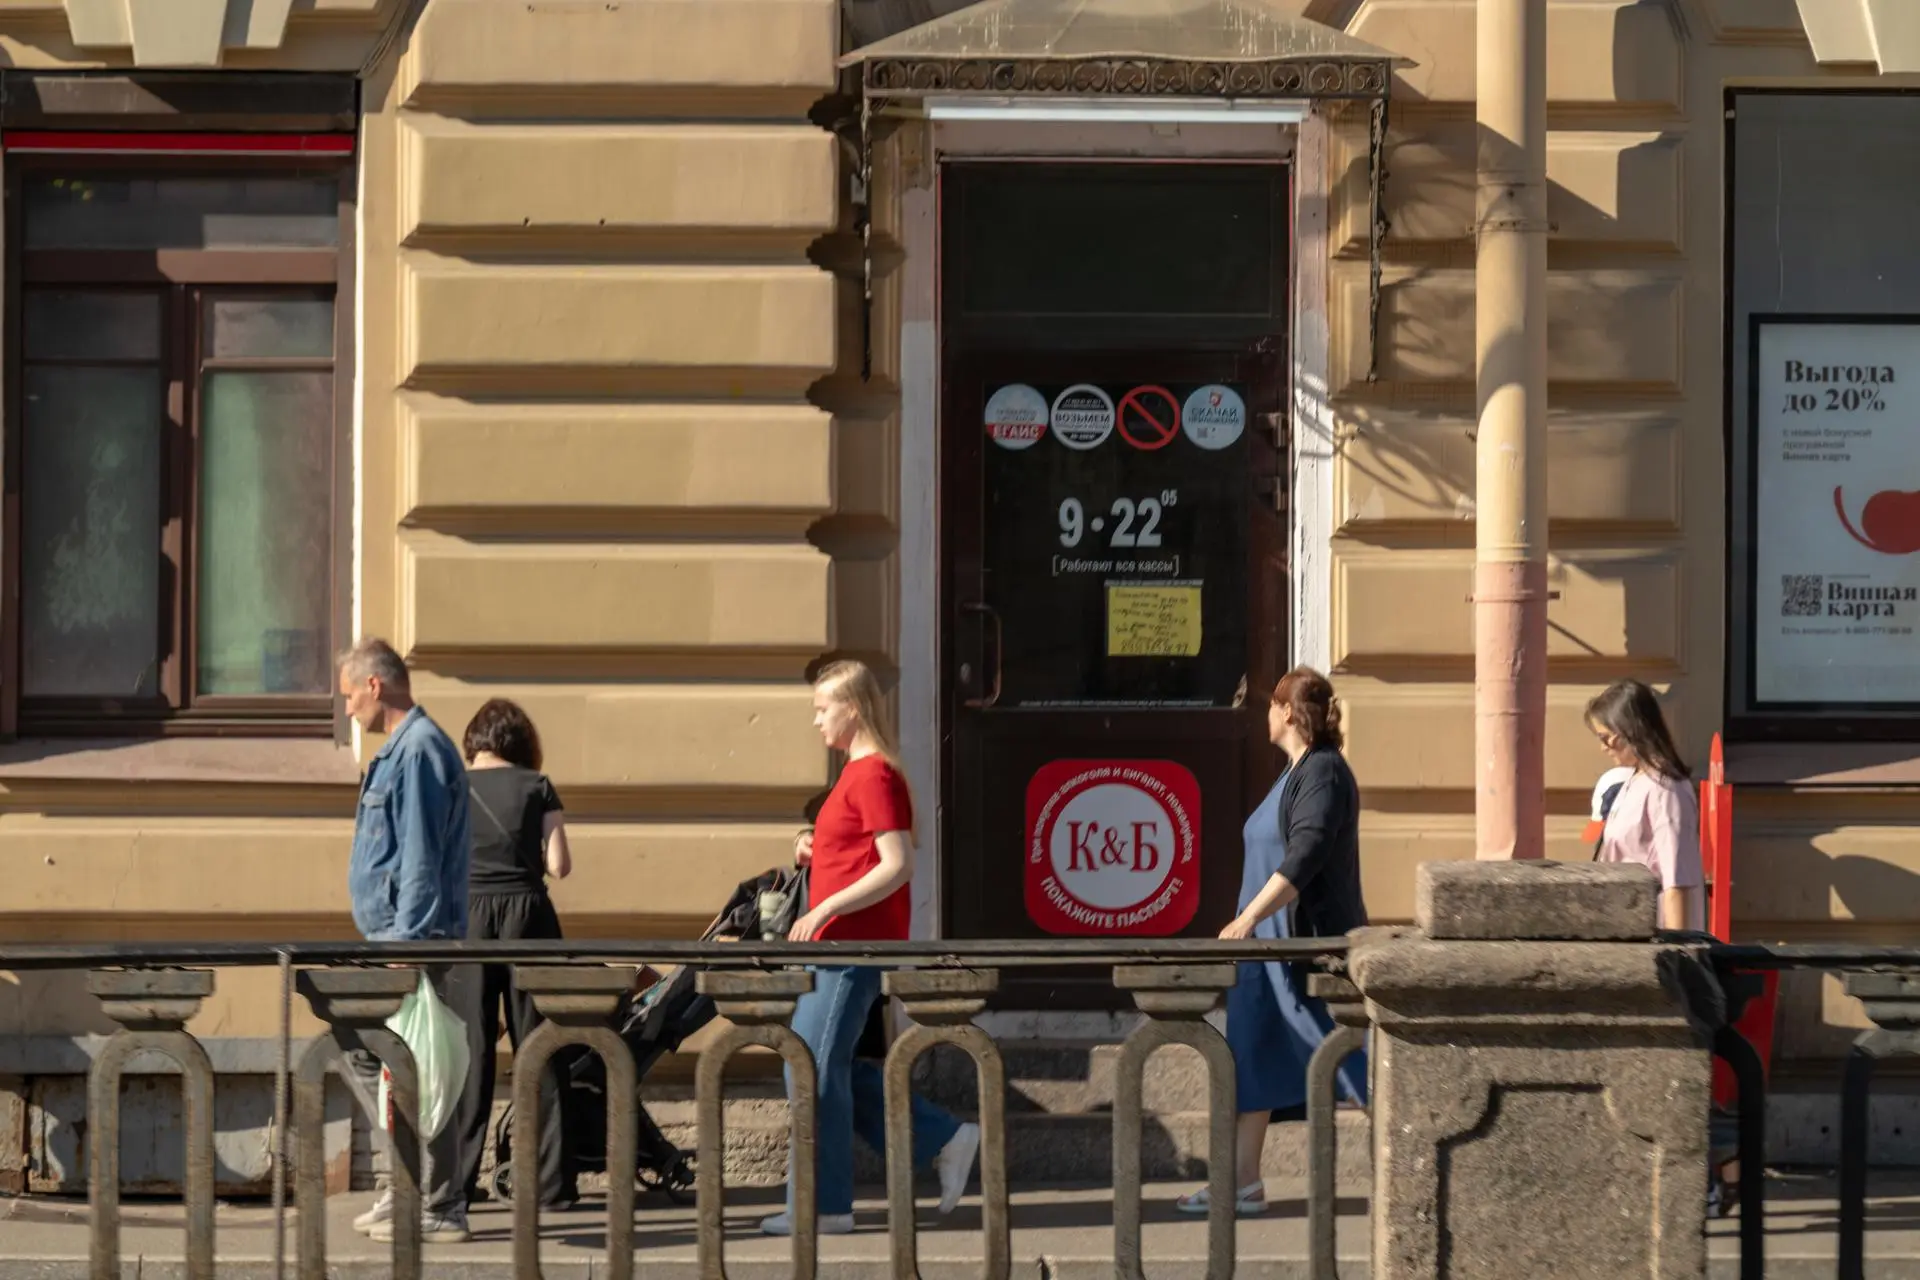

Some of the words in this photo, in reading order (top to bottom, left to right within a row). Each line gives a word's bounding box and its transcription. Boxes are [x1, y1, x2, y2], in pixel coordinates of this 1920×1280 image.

[1784, 359, 1895, 386] Выгода
[1782, 393, 1818, 414] до
[1825, 388, 1886, 412] 20%
[1827, 581, 1917, 601] Винная
[1827, 602, 1895, 621] карта
[1040, 875, 1115, 929] ПОКАЖИТЕ
[1116, 877, 1184, 929] ПАСПОРТ!
